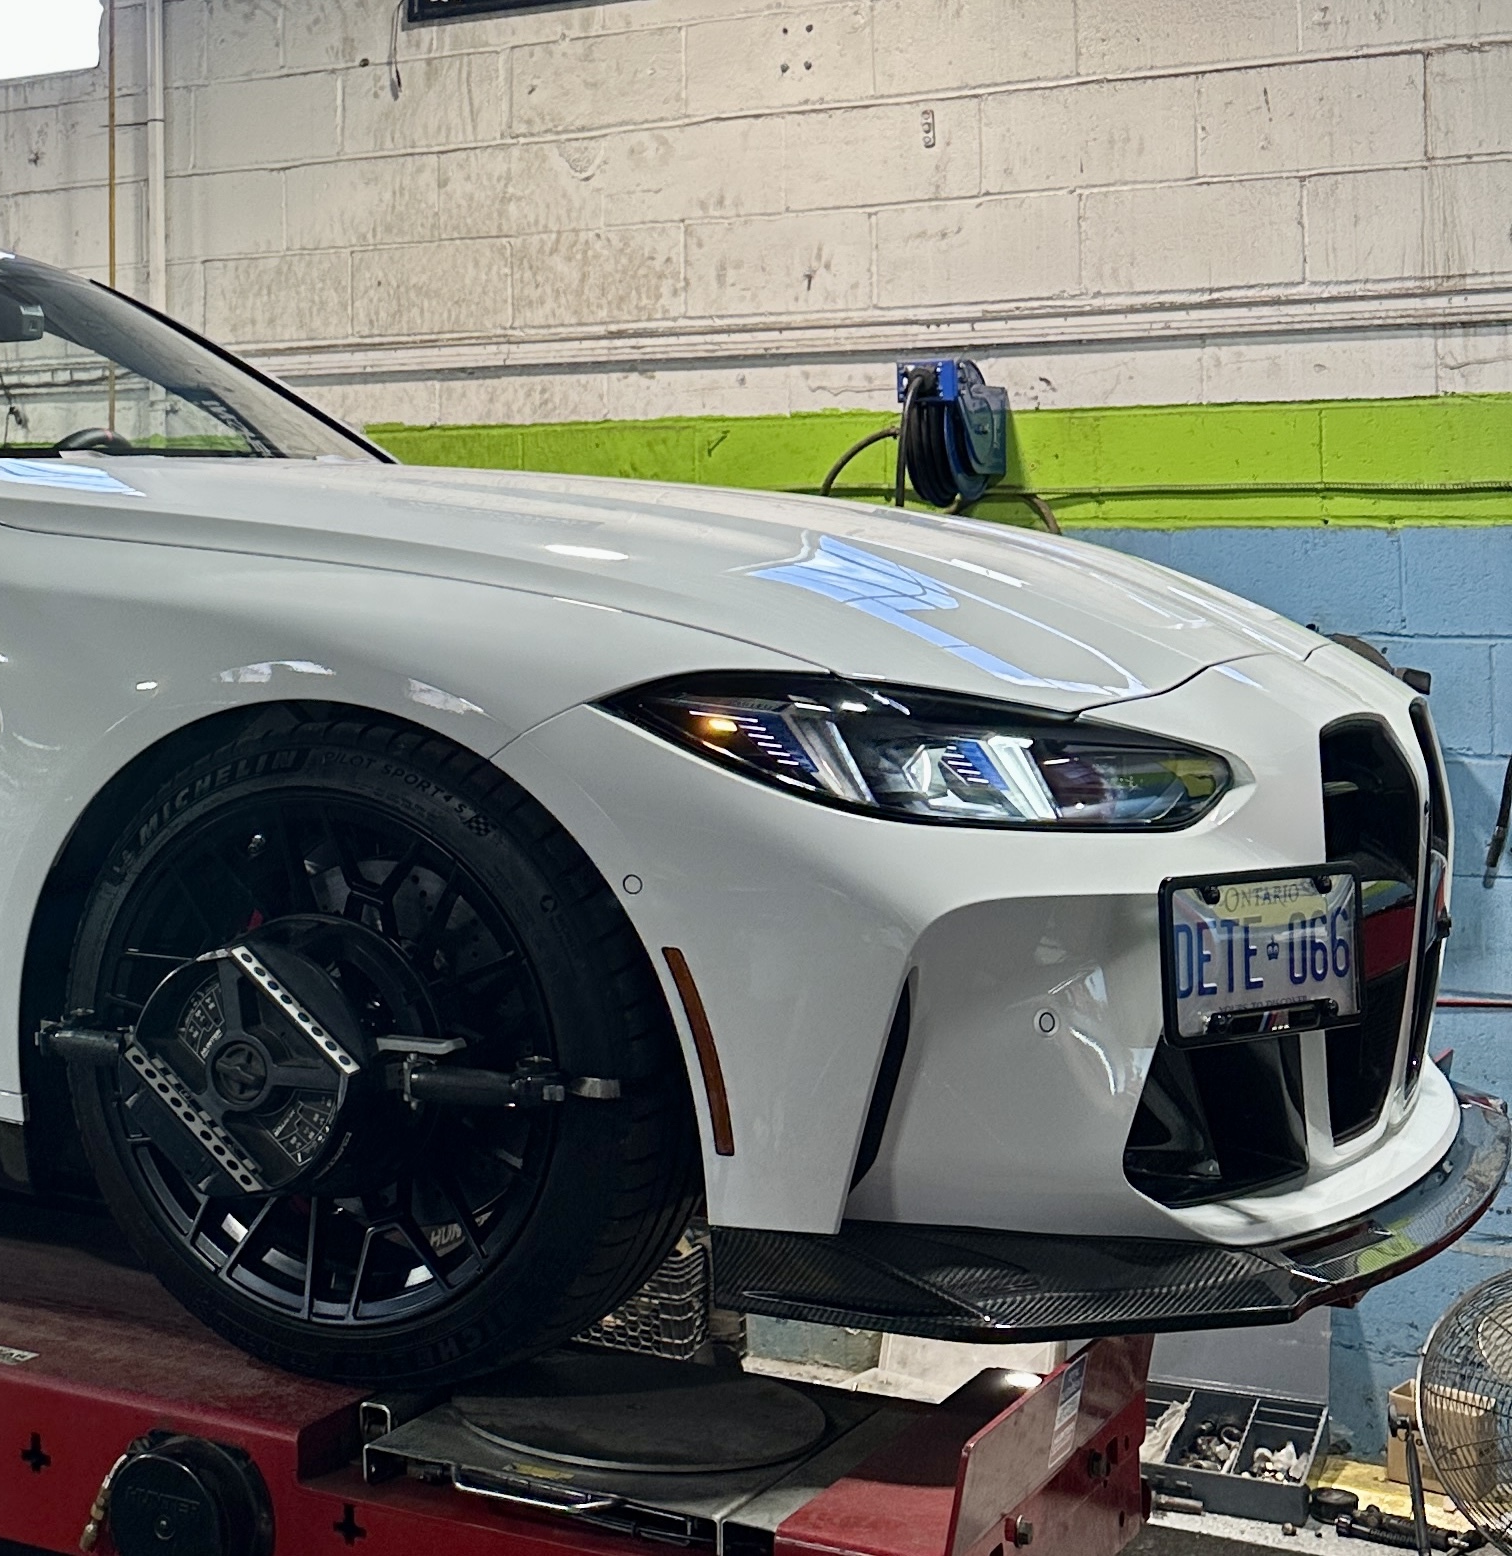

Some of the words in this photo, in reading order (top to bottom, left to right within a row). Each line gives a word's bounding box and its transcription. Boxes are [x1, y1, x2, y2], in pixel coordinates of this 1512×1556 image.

[139, 750, 297, 847] MICHELIN
[324, 752, 376, 769] PILOT
[381, 765, 444, 797] SPORT
[1225, 884, 1299, 912] ONTARIO
[1174, 915, 1264, 999] DETE
[1288, 906, 1351, 986] 066
